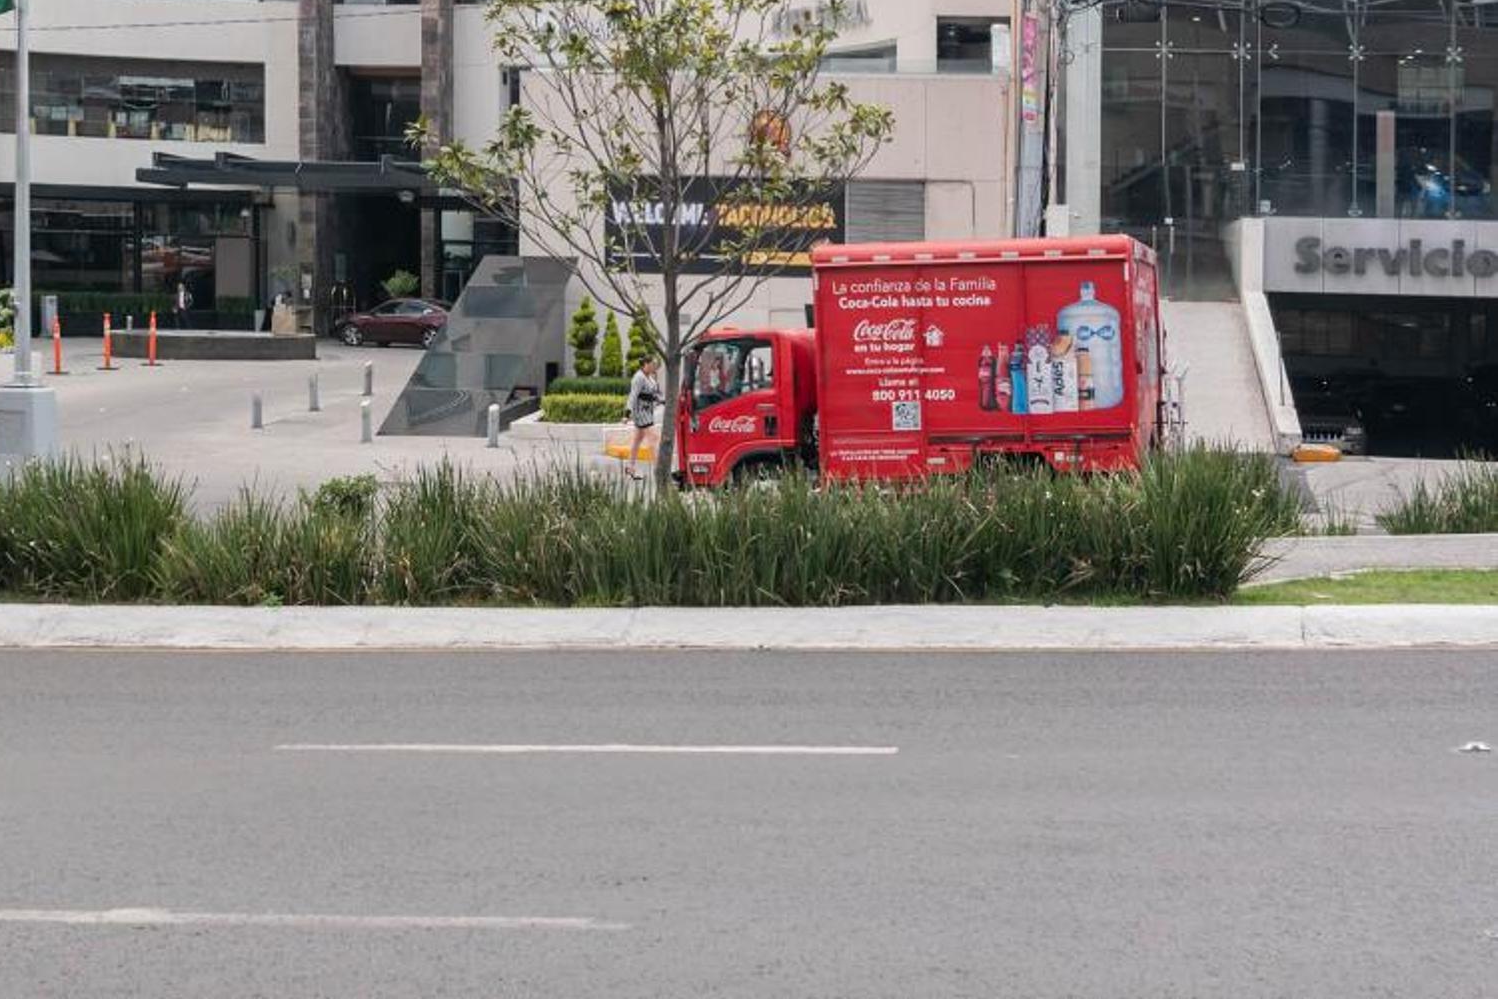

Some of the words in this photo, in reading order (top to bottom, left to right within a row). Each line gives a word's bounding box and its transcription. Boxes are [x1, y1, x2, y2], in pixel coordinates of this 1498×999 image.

[612, 201, 708, 225] WELCM
[1294, 236, 1498, 278] Servicio
[832, 281, 847, 295] La
[850, 278, 911, 293] confianza
[915, 279, 932, 292] de
[935, 277, 946, 291] la
[950, 277, 997, 291] Familia
[838, 295, 899, 309] Coca-Cola
[902, 295, 933, 308] hasta
[936, 296, 950, 307] tu
[952, 294, 991, 307] cocina
[884, 341, 915, 353] hogar
[872, 389, 896, 401] 800
[898, 389, 920, 401] 911
[924, 389, 956, 400] 4050
